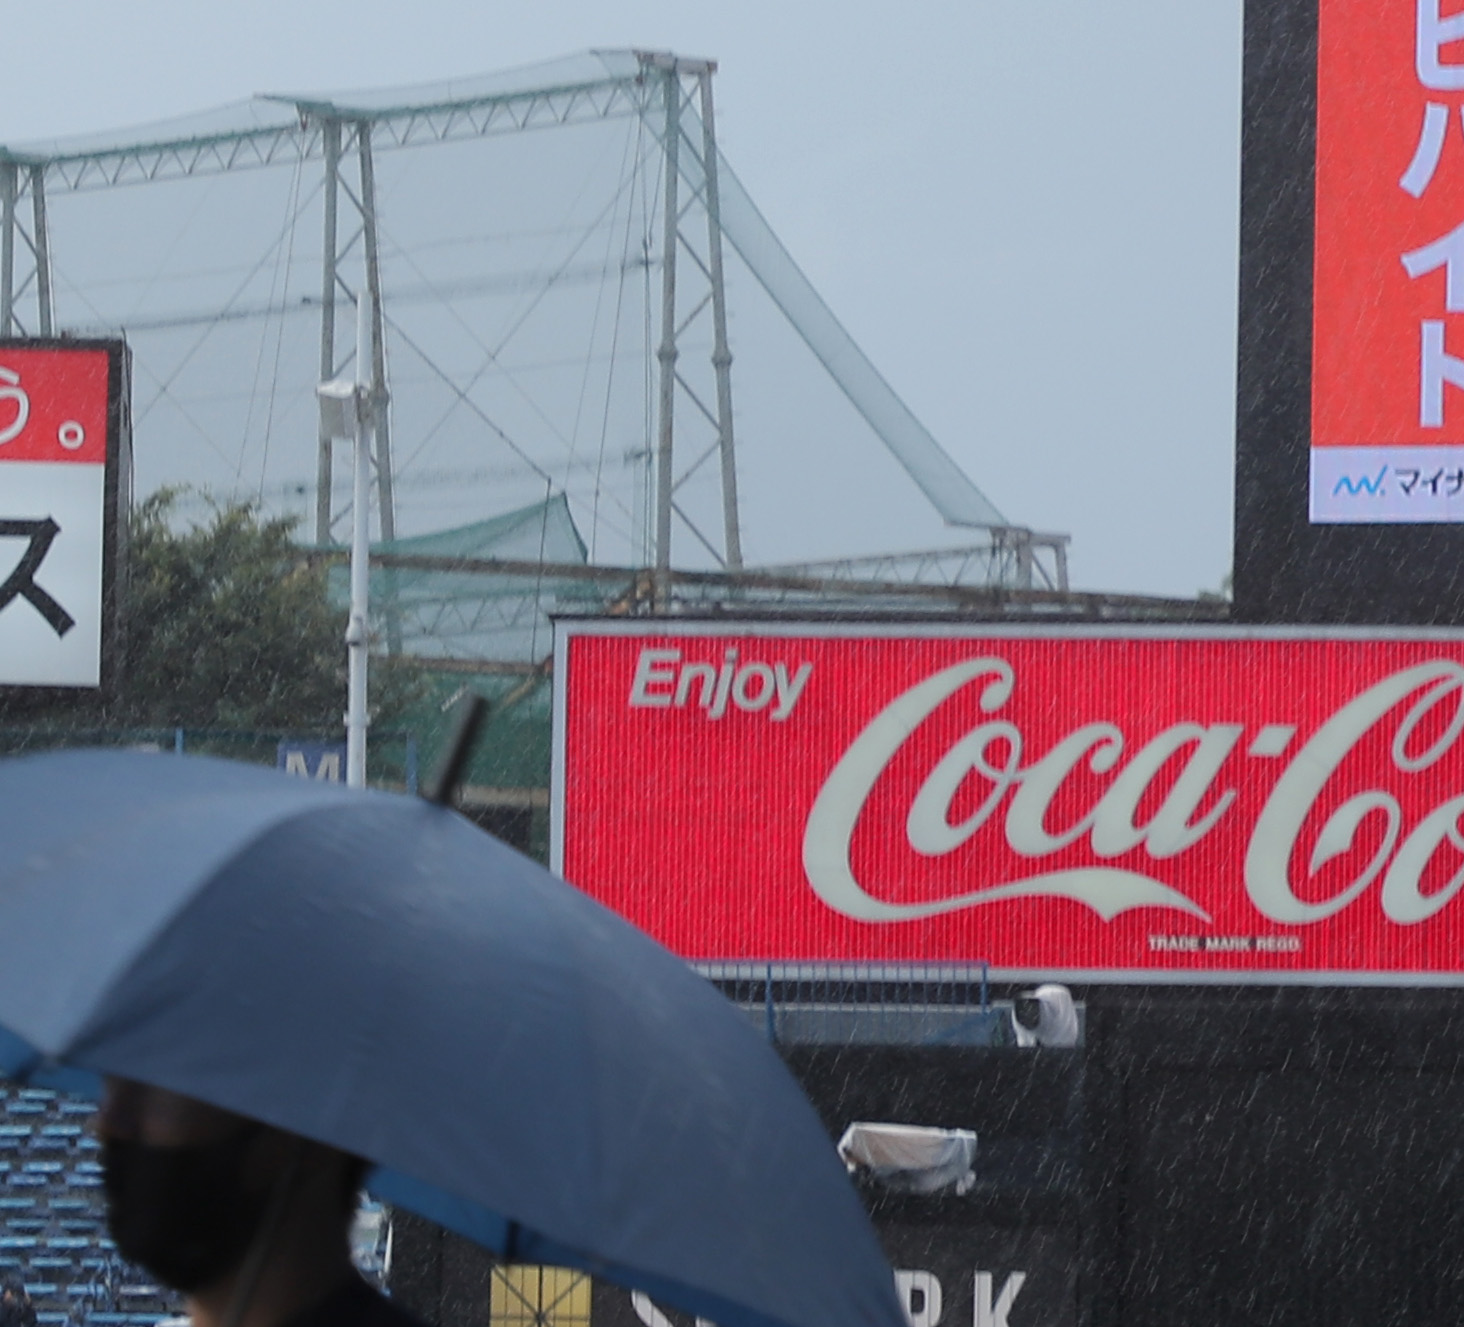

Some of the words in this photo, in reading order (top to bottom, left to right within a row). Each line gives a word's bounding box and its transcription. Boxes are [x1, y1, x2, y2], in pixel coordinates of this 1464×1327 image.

[628, 645, 813, 722] Enjoy
[1149, 935, 1199, 953] TRADE
[1205, 935, 1251, 953] MARK
